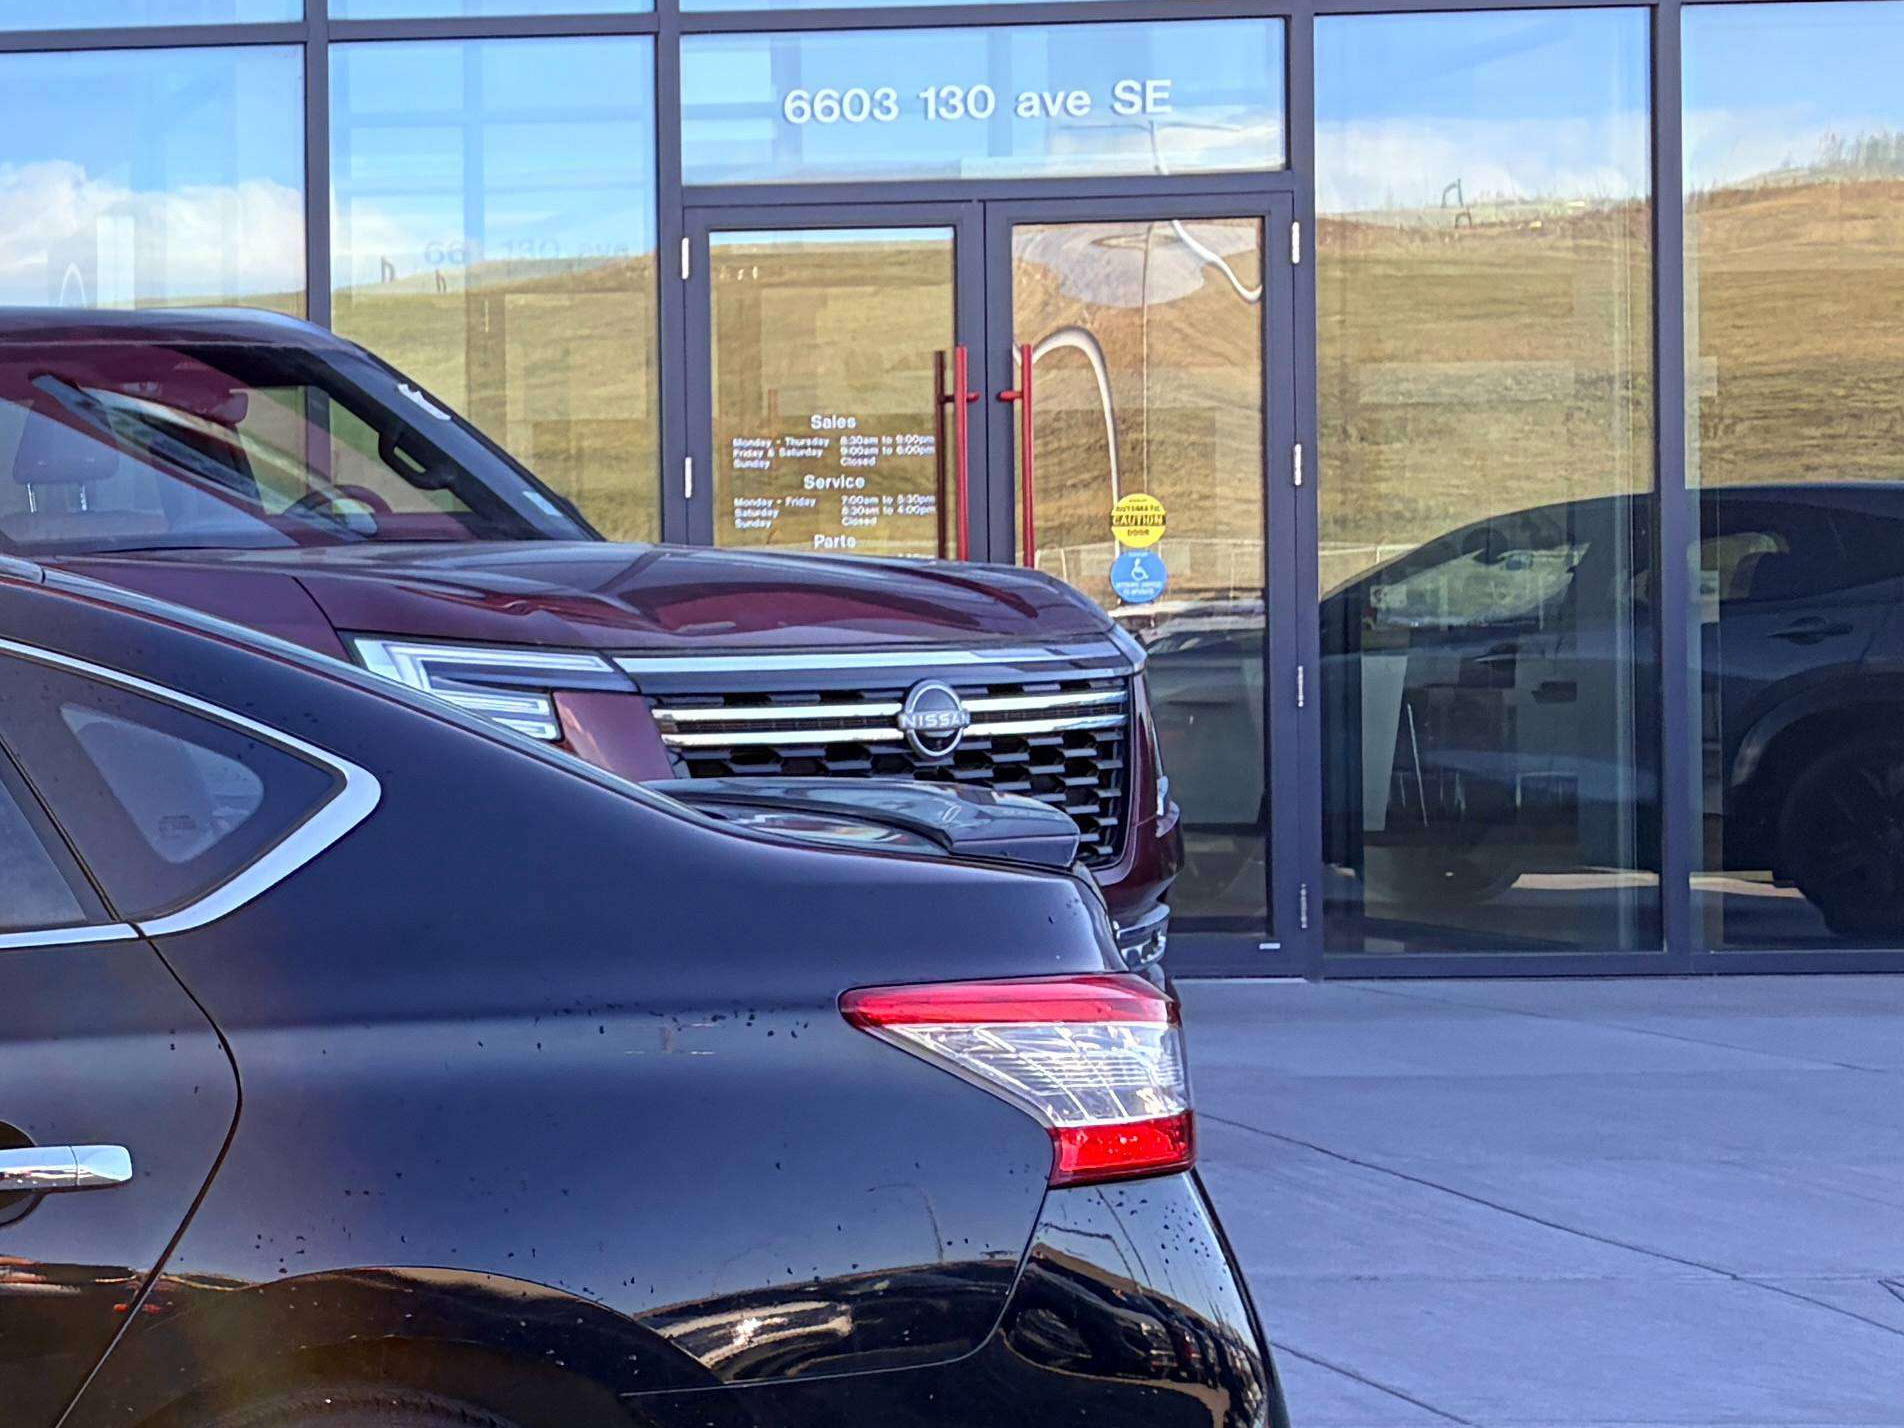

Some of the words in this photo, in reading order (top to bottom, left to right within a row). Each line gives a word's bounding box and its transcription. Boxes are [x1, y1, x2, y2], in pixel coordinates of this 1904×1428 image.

[784, 87, 899, 125] 6603
[918, 84, 996, 121] 130
[1016, 88, 1092, 119] ave
[1111, 79, 1173, 116] SE
[810, 414, 857, 430] Sales
[733, 438, 772, 449] Monday
[785, 436, 830, 447] Thursday
[882, 435, 892, 445] to
[733, 448, 764, 459] Friday
[779, 447, 823, 458] Saturday
[882, 446, 892, 456] to
[733, 459, 771, 470] Sunday
[840, 456, 876, 467] Closed
[804, 474, 866, 490] Service
[734, 497, 773, 508] Monday
[785, 496, 816, 507] Friday
[882, 495, 892, 505] to
[734, 508, 780, 518] Saturday
[882, 506, 893, 516] to
[735, 518, 772, 529] Sunday
[841, 516, 877, 527] Closed
[1113, 515, 1164, 526] CAUTION
[814, 534, 857, 549] Parts
[901, 712, 970, 728] NISSAN
